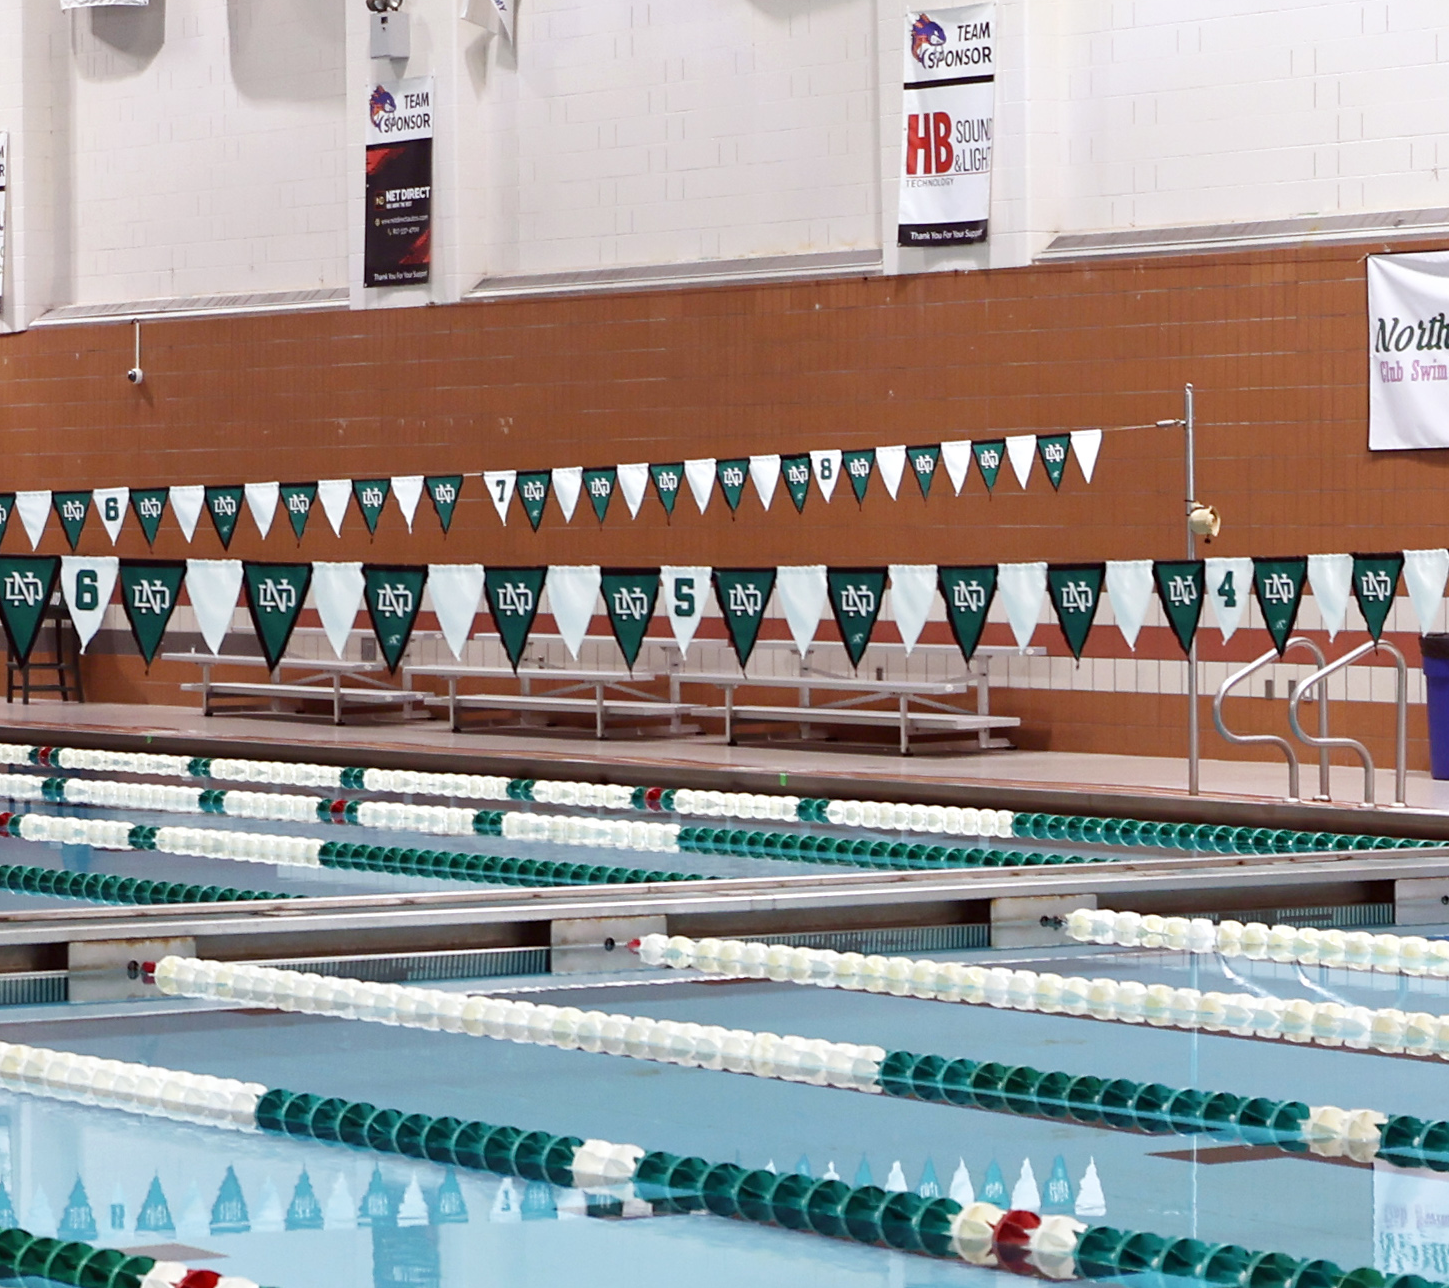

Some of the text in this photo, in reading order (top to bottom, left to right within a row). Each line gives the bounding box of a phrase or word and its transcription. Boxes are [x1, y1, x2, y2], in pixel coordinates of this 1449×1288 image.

[958, 22, 990, 41] TEAM
[928, 46, 992, 68] SPONSOR
[405, 92, 429, 109] TEAM
[384, 113, 430, 132] SPONSOR
[906, 111, 954, 175] HB
[906, 178, 953, 187] TECHNOLOGY
[386, 186, 431, 202] NET DIRECT
[1380, 359, 1448, 383] Club Swim
[820, 458, 832, 480] 8
[105, 497, 118, 522] 6
[76, 570, 98, 610] 6
[674, 579, 695, 617] 5
[1218, 572, 1237, 608] 4
